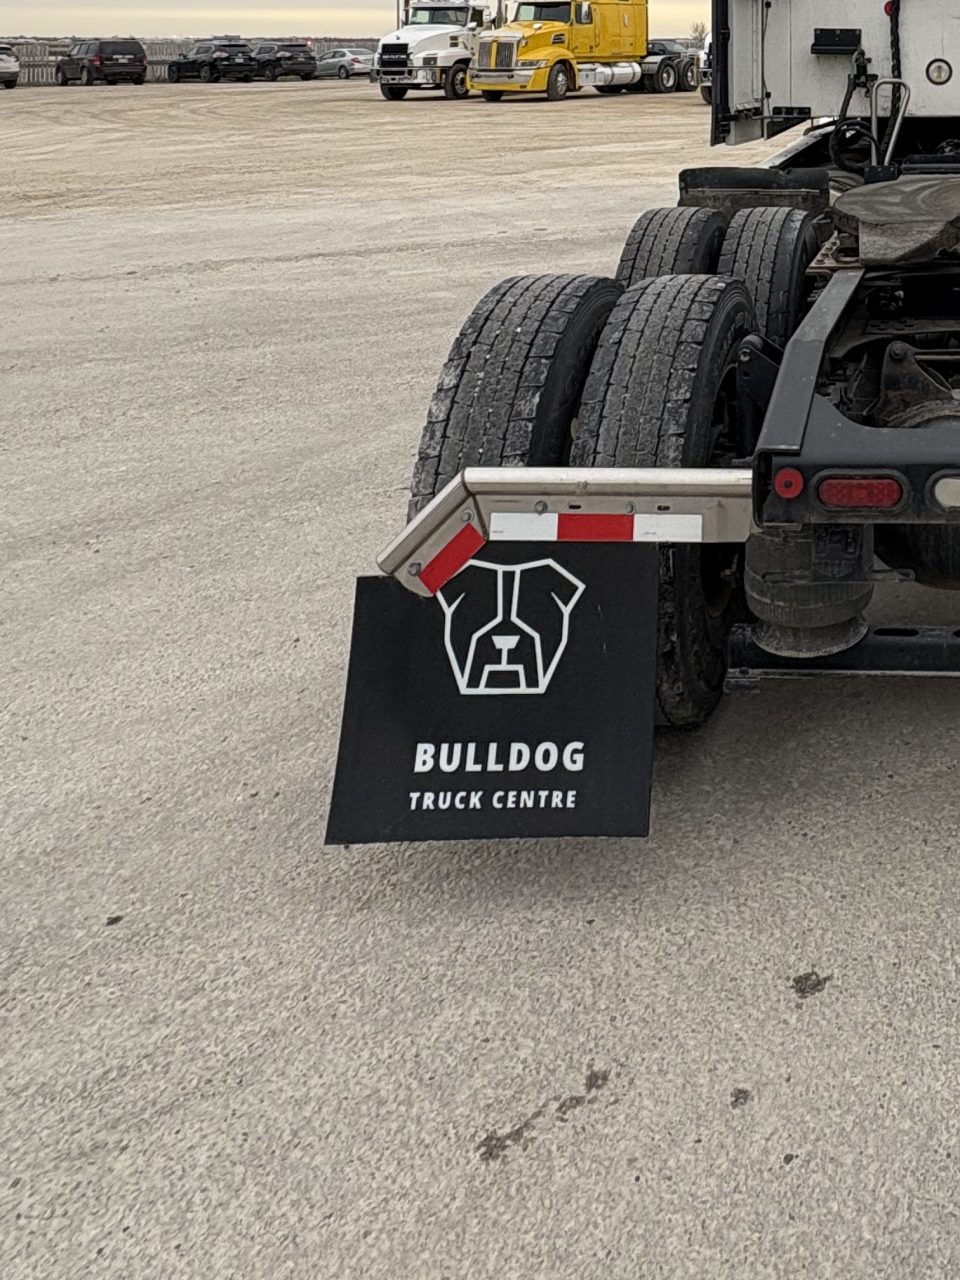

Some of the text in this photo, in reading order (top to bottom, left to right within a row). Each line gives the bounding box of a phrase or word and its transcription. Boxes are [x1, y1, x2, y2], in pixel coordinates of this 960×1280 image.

[413, 741, 585, 773] BULLDOG
[409, 789, 577, 811] TRUCK CENTRE
